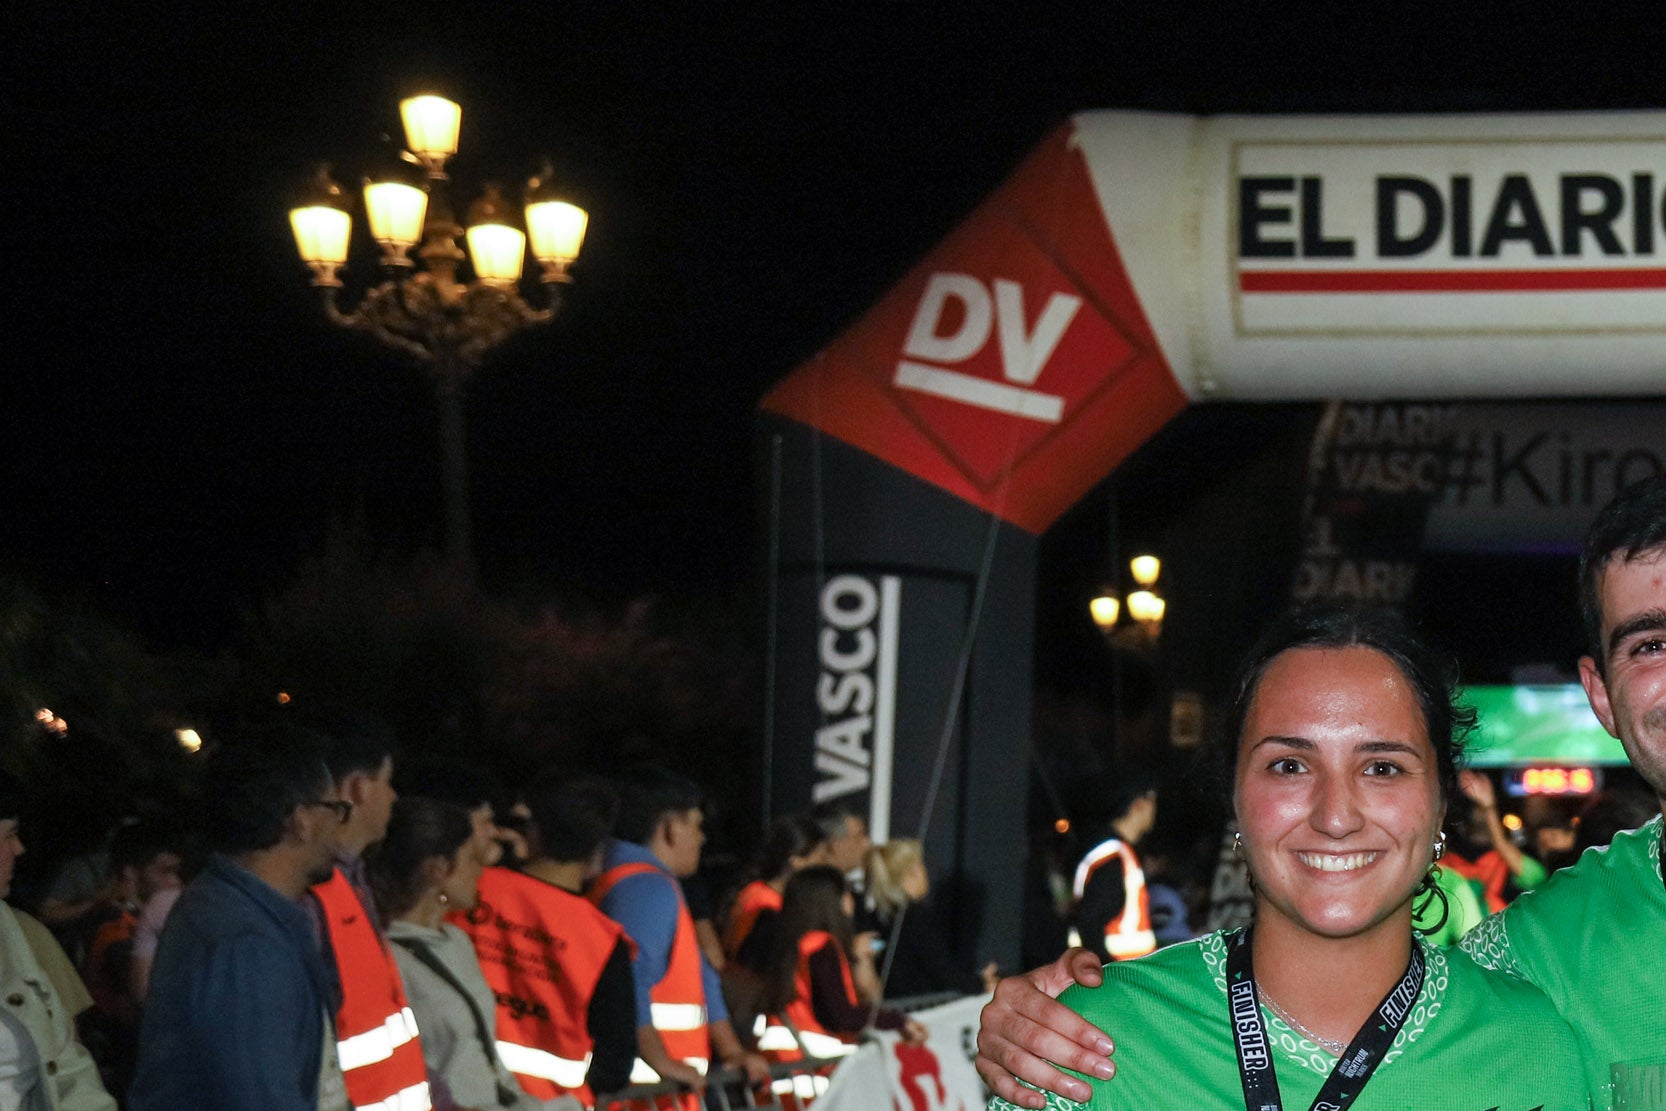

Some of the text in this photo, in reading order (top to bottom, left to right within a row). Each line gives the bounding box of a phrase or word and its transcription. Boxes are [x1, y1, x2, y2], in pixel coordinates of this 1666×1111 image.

[1239, 175, 1356, 258] EL
[901, 272, 1084, 385] DV
[812, 574, 879, 803] VASCO
[1231, 980, 1269, 1071] FINISHER
